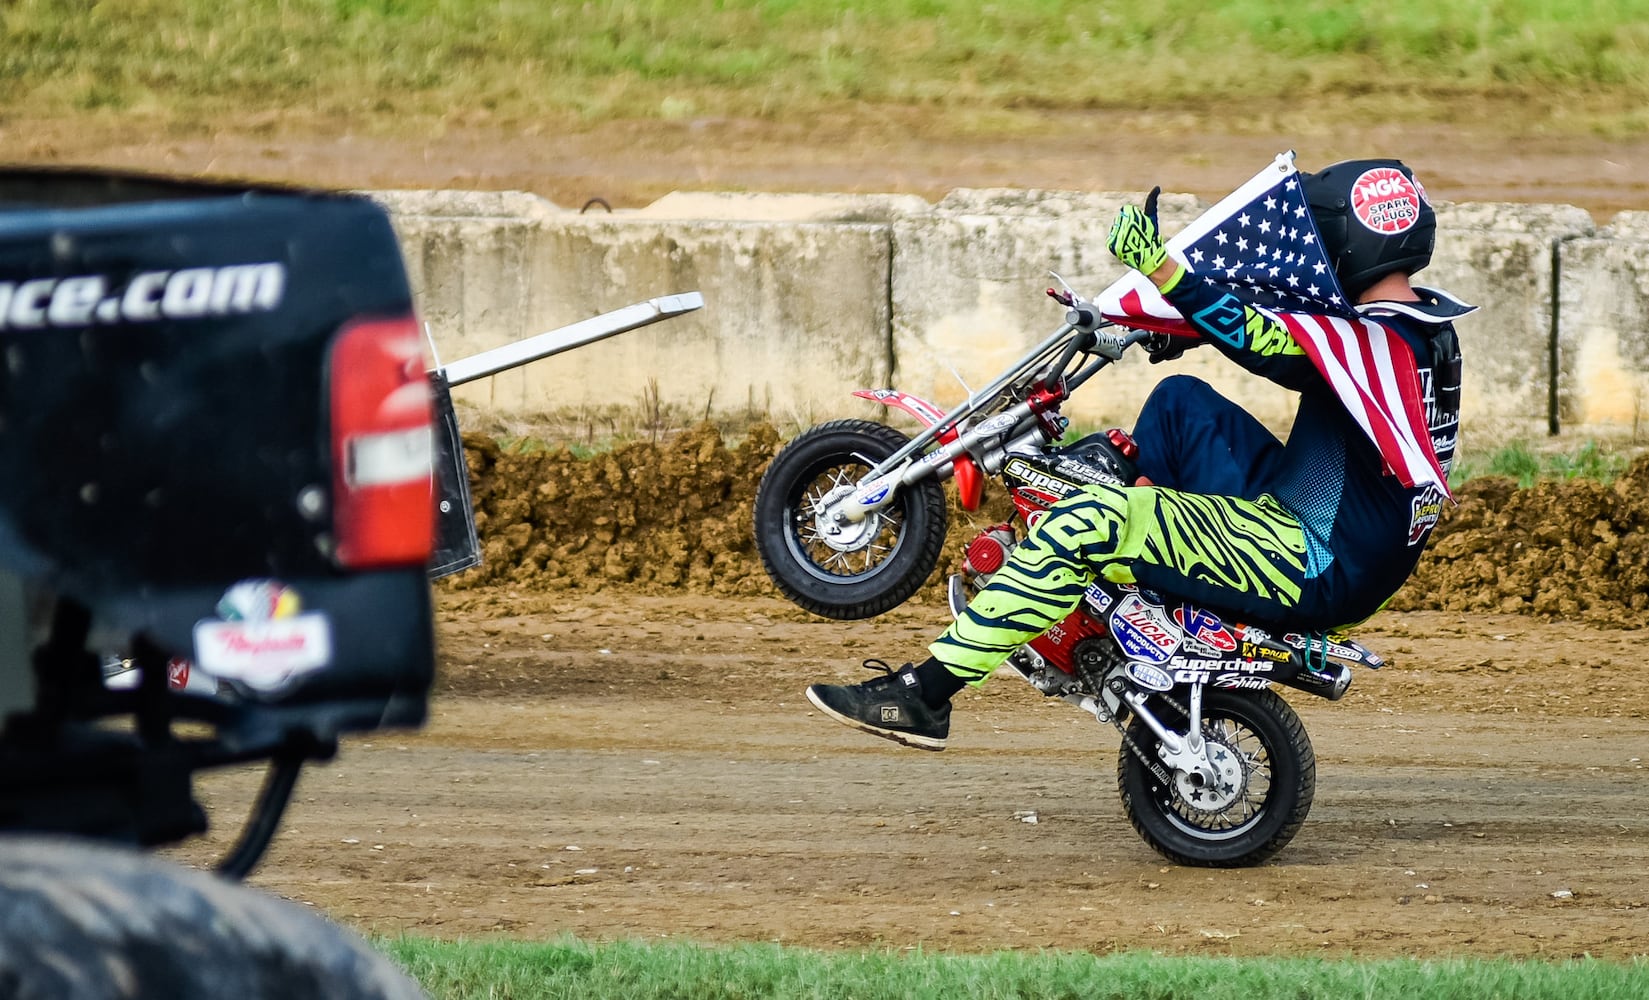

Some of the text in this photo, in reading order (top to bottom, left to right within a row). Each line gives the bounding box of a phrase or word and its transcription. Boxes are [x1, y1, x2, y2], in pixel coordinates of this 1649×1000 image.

[1360, 177, 1406, 200] NGK
[1370, 198, 1410, 214] SPARK
[1373, 209, 1413, 225] PLUGS
[1061, 459, 1120, 485] Fusion
[1085, 585, 1110, 606] EBC
[1113, 618, 1126, 631] OIL
[1126, 629, 1165, 661] PRODUCTS
[1124, 611, 1175, 647] LUCAS
[1166, 656, 1273, 674] Superchips
